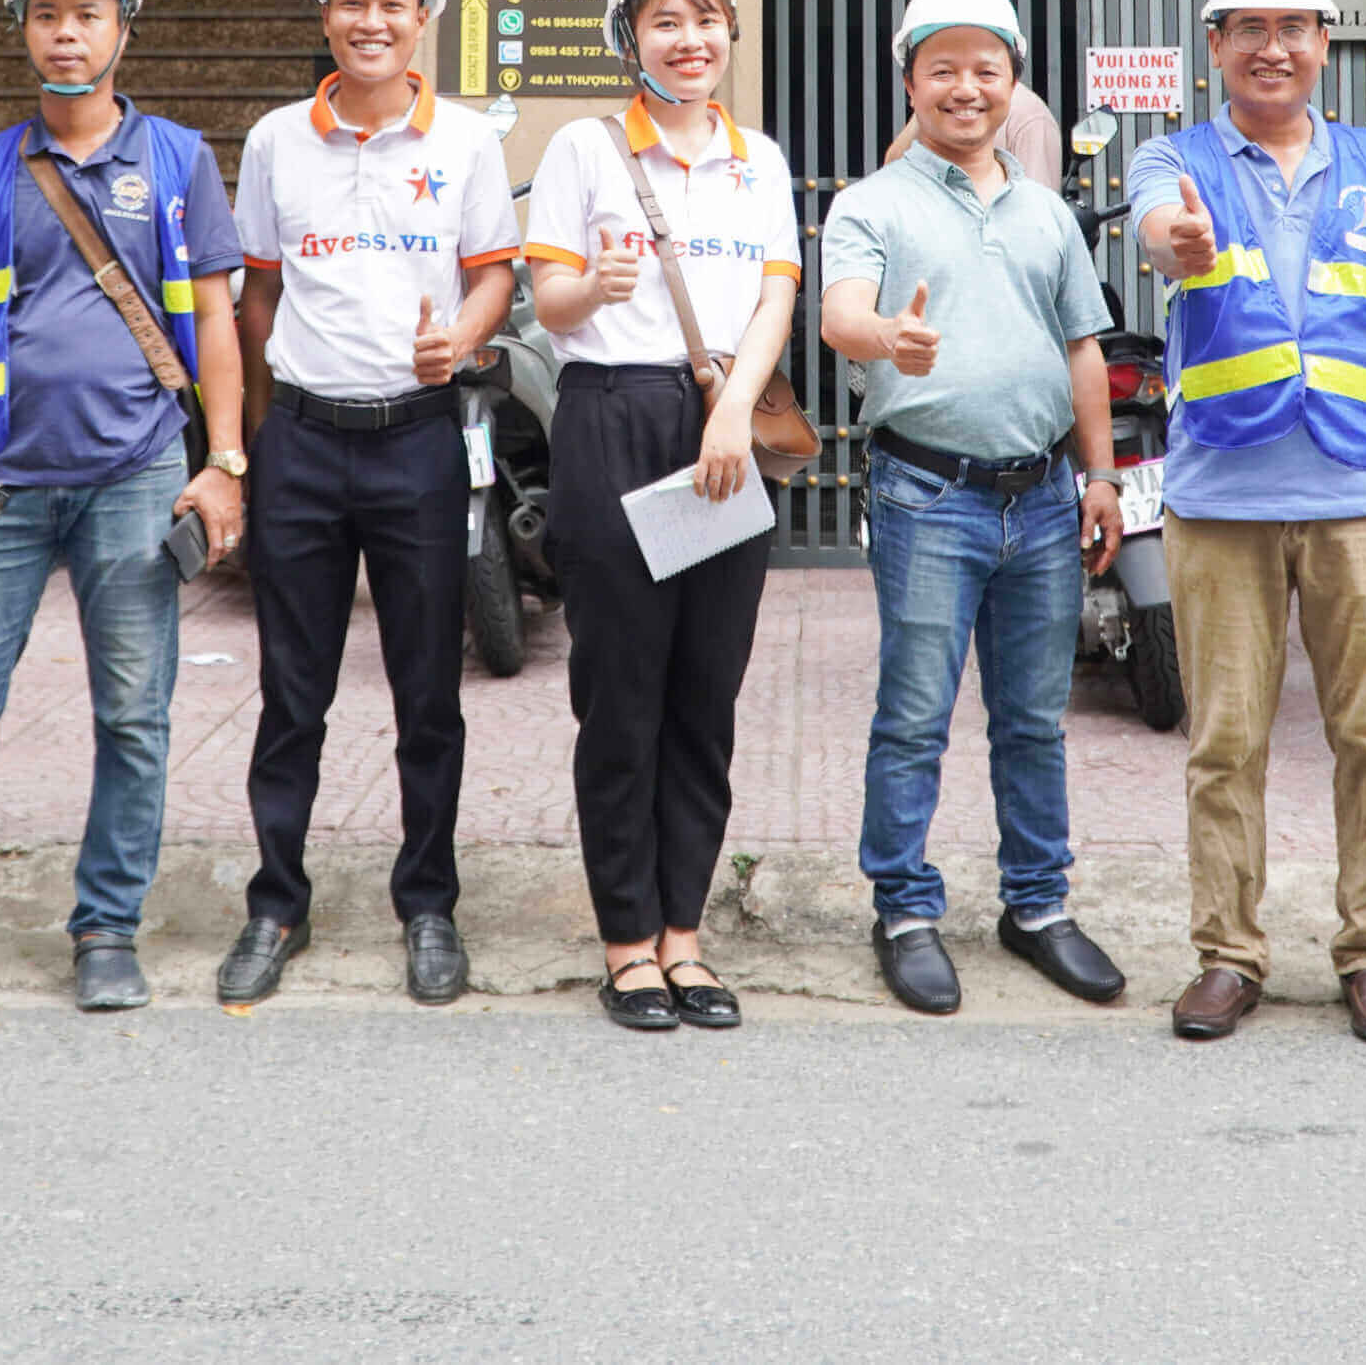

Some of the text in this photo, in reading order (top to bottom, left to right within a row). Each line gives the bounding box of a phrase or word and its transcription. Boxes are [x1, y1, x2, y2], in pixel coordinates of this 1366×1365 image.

[1096, 51, 1175, 68] VUI LÒNG
[546, 74, 563, 85] AN
[1157, 74, 1178, 88] XE
[300, 233, 439, 257] fivess.vn
